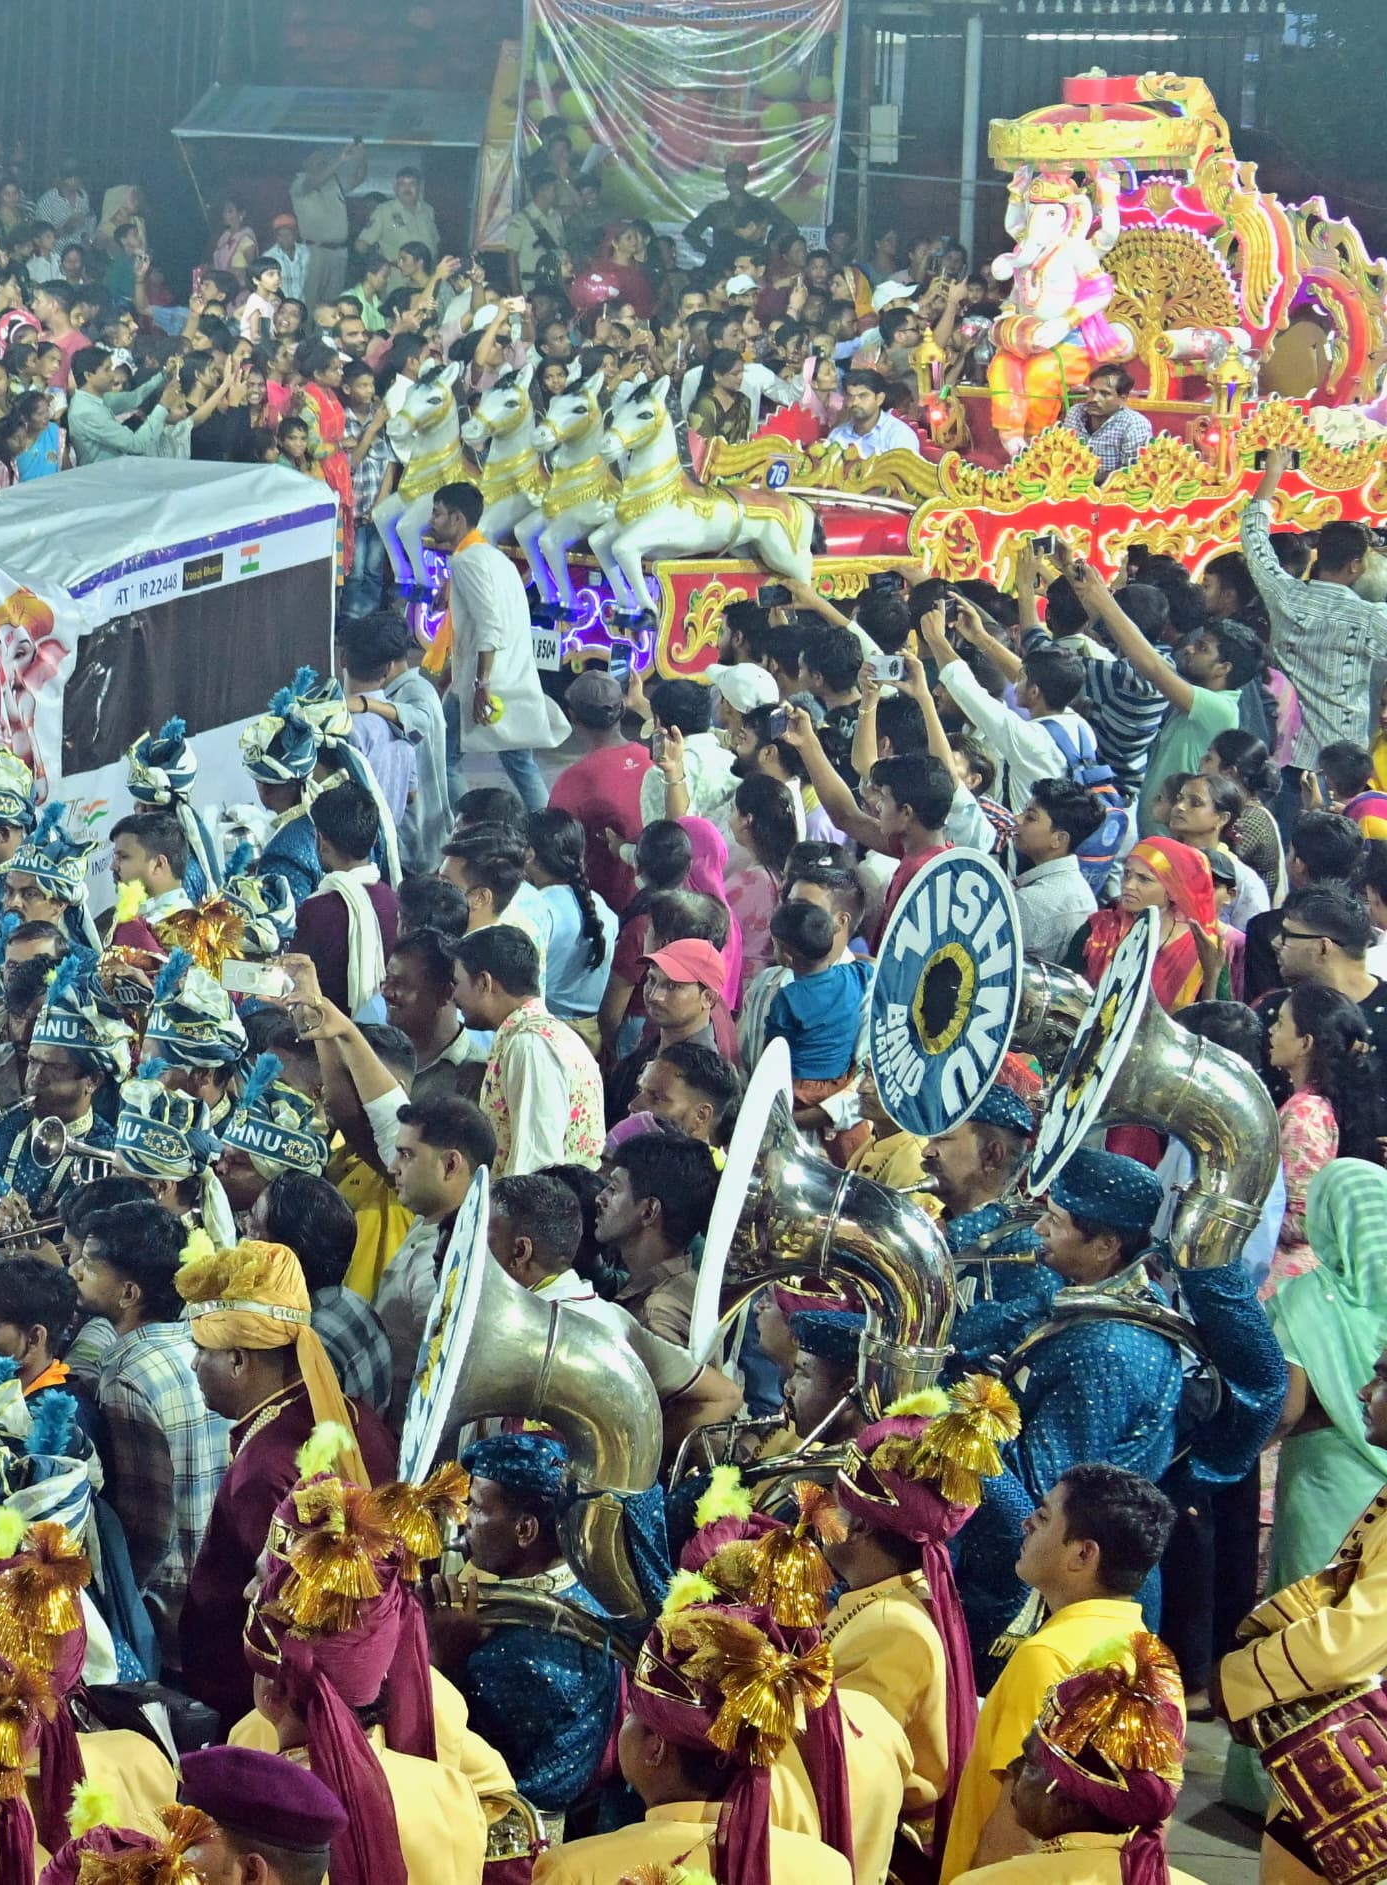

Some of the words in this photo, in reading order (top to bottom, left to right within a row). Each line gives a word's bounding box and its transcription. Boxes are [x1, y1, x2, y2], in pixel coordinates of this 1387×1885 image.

[768, 464, 788, 486] 76
[149, 573, 178, 596] 22448
[893, 869, 1012, 1117] VISHNU
[875, 1017, 905, 1109] JAIPUR
[887, 1003, 926, 1097] BAND
